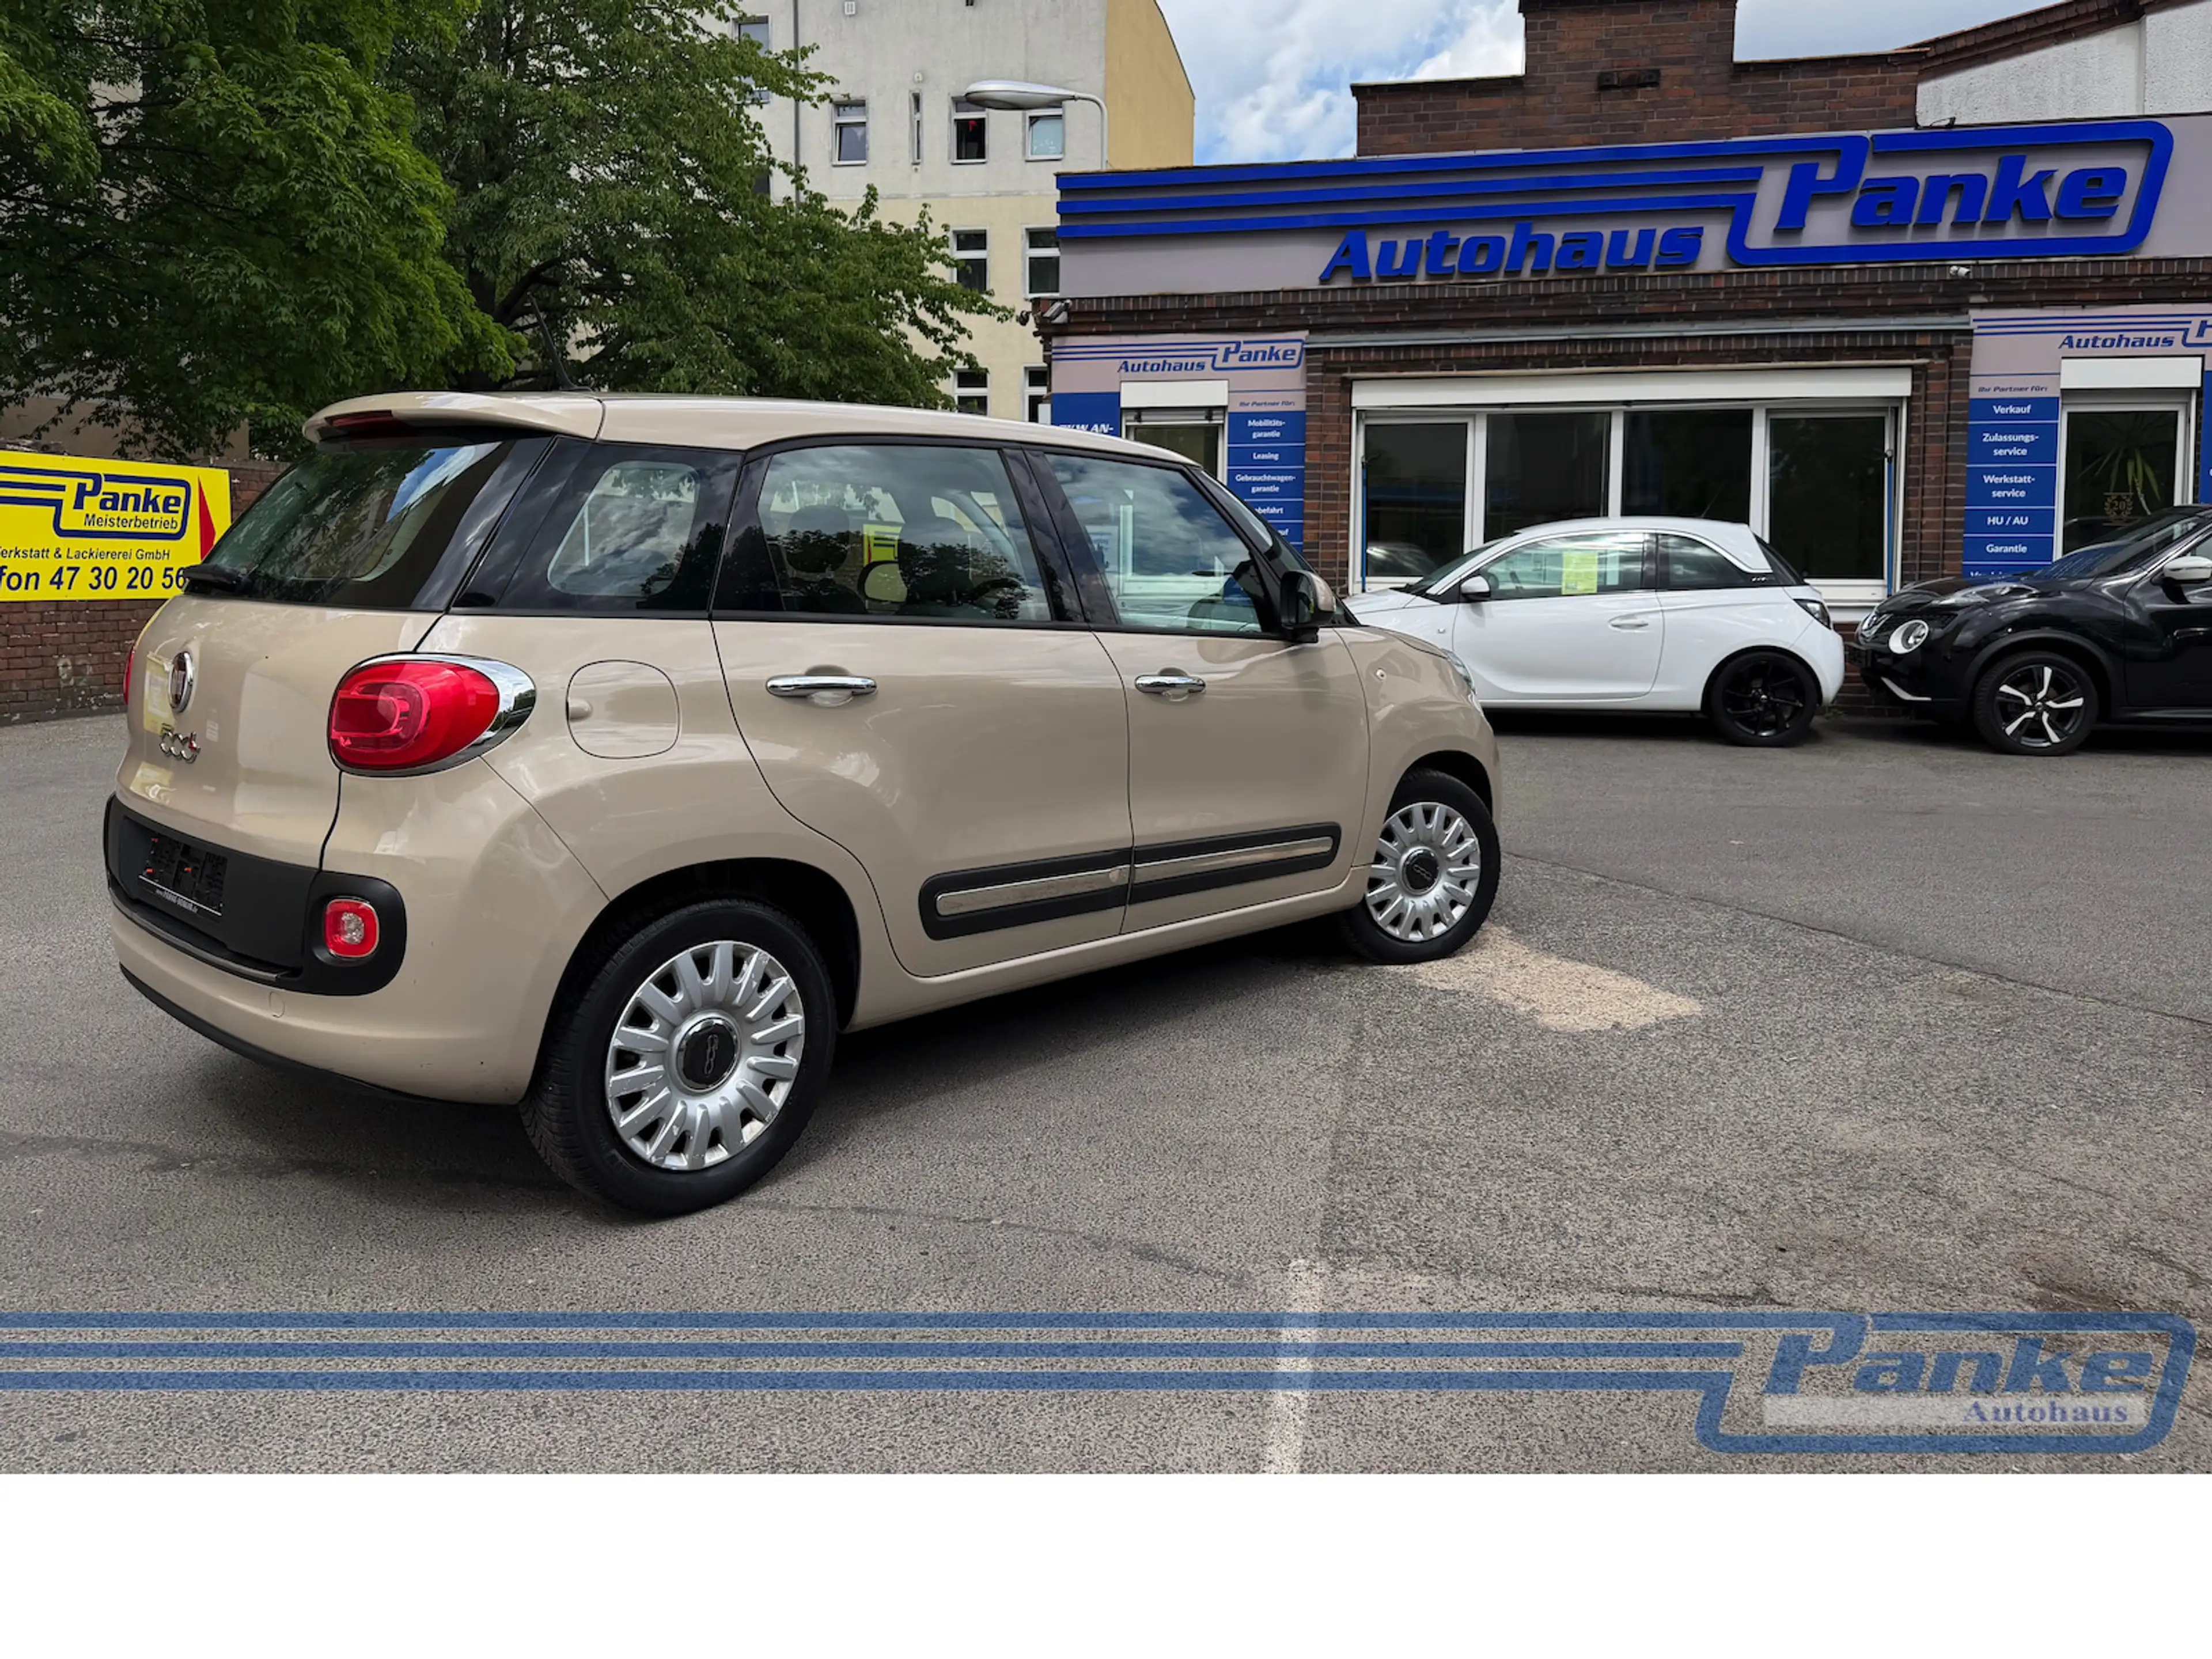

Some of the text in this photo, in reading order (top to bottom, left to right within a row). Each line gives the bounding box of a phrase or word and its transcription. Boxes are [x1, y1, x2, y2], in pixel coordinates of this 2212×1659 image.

[1774, 143, 2128, 232] Panke
[1319, 221, 1704, 282] Autohaus
[2058, 334, 2175, 350] Autohaus
[1222, 341, 1297, 363] Panke
[1118, 359, 1206, 373] Autohaus
[1993, 404, 2032, 414] Verkauf
[1247, 418, 1286, 427] Mobilitäts-
[1252, 429, 1281, 439] garantie
[1982, 433, 2039, 444] Zulassungs-
[1252, 450, 1279, 461] Leasing
[1993, 446, 2028, 456] service
[1235, 474, 1296, 483] Gebrauchtwagen-
[1983, 474, 2036, 485] Werkstatt-
[1251, 484, 1279, 494] garantie
[1991, 488, 2027, 498] service
[73, 477, 182, 514] Panke
[84, 513, 179, 530] Meisterbetrieb
[1987, 516, 2004, 525] HU
[2012, 516, 2029, 525] AU
[0, 546, 171, 560] erkstatt & Lackiererei GmbH
[1986, 543, 2028, 554] Garantie
[50, 566, 81, 590] 47
[89, 566, 118, 590] 30
[126, 566, 154, 590] 20
[162, 567, 187, 590] 56
